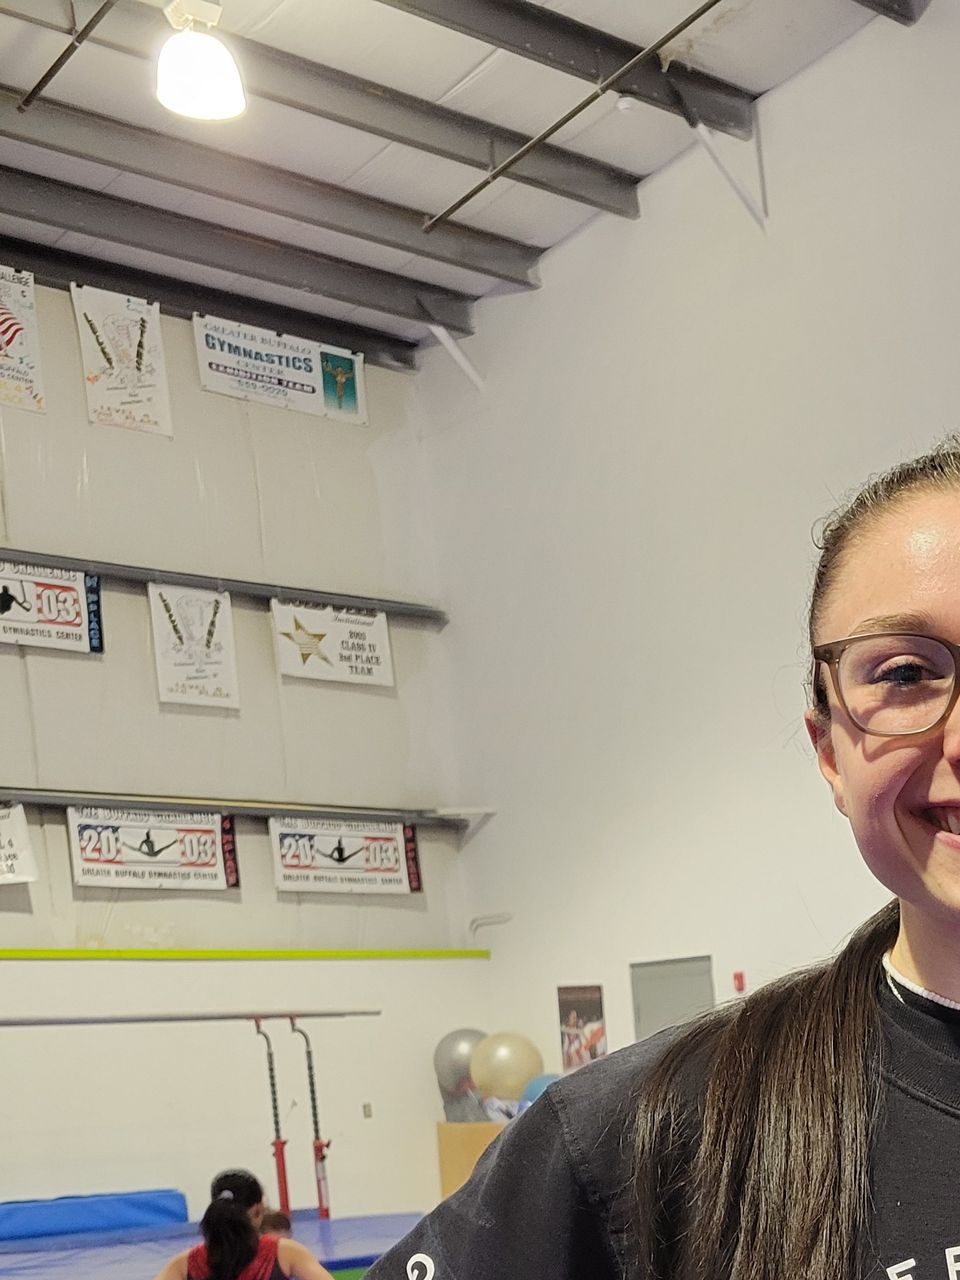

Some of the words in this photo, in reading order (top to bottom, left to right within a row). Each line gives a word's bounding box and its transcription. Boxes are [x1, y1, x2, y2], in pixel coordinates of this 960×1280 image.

[204, 332, 314, 374] GYMNASTICS
[40, 587, 79, 622] 03
[81, 828, 118, 861] 20
[182, 832, 214, 865] 03
[283, 836, 313, 867] 20
